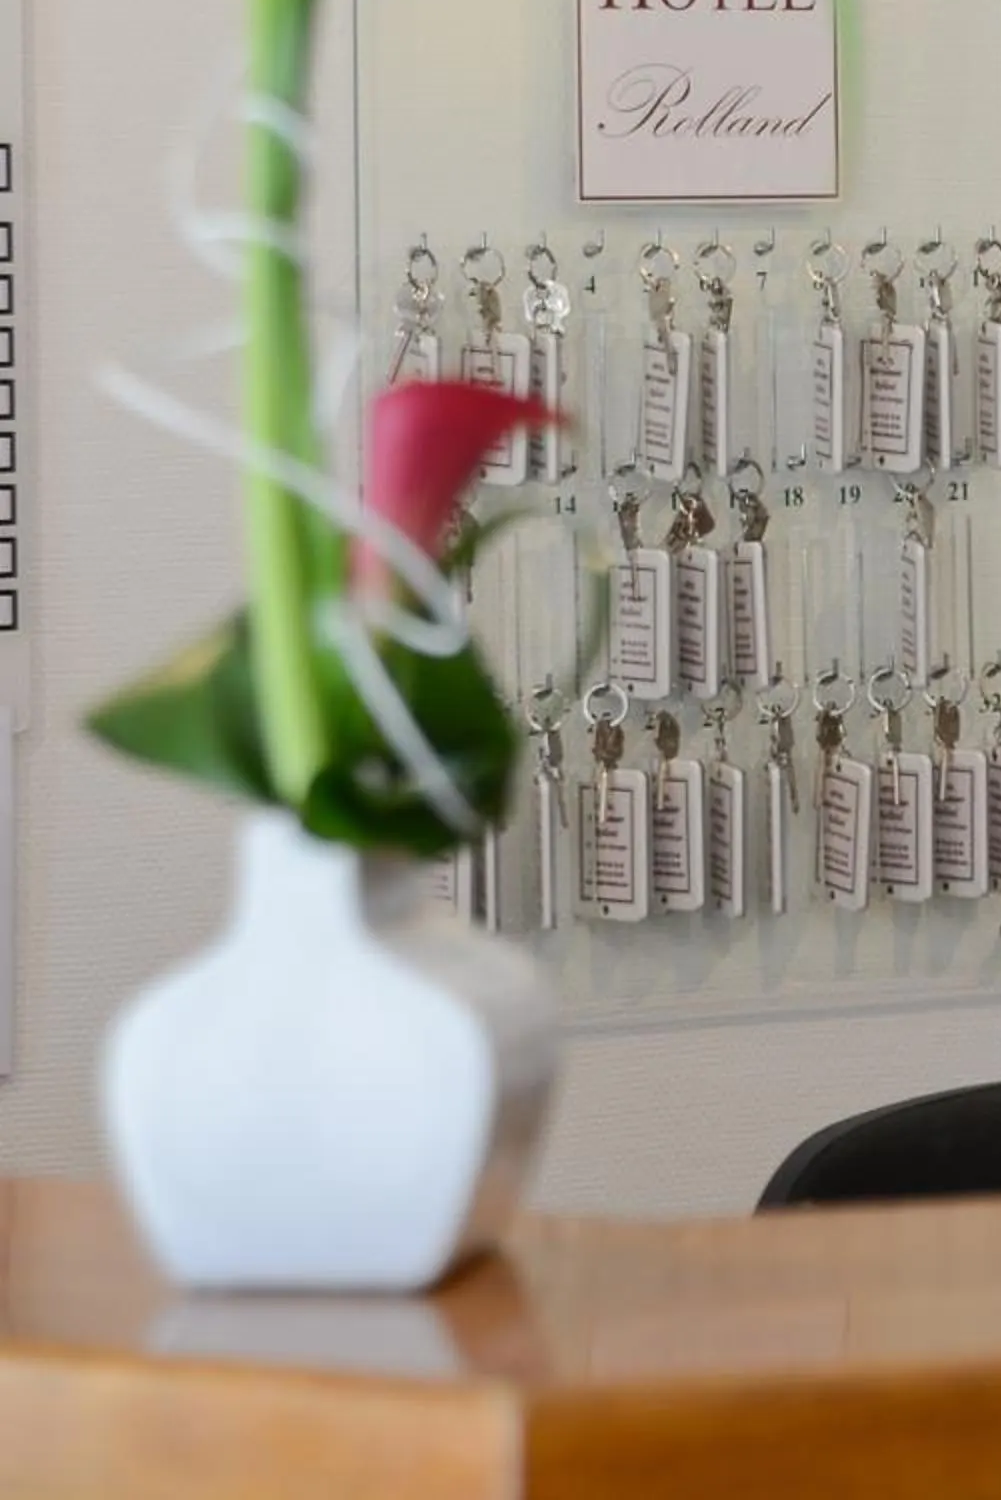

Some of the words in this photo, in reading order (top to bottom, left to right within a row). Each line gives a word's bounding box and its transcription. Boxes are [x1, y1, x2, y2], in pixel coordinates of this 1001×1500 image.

[597, 62, 832, 138] Rolland
[583, 275, 596, 295] 4
[756, 271, 768, 291] 7
[554, 494, 577, 515] 14
[783, 486, 804, 507] 18
[840, 483, 861, 505] 19
[947, 481, 969, 502] 21
